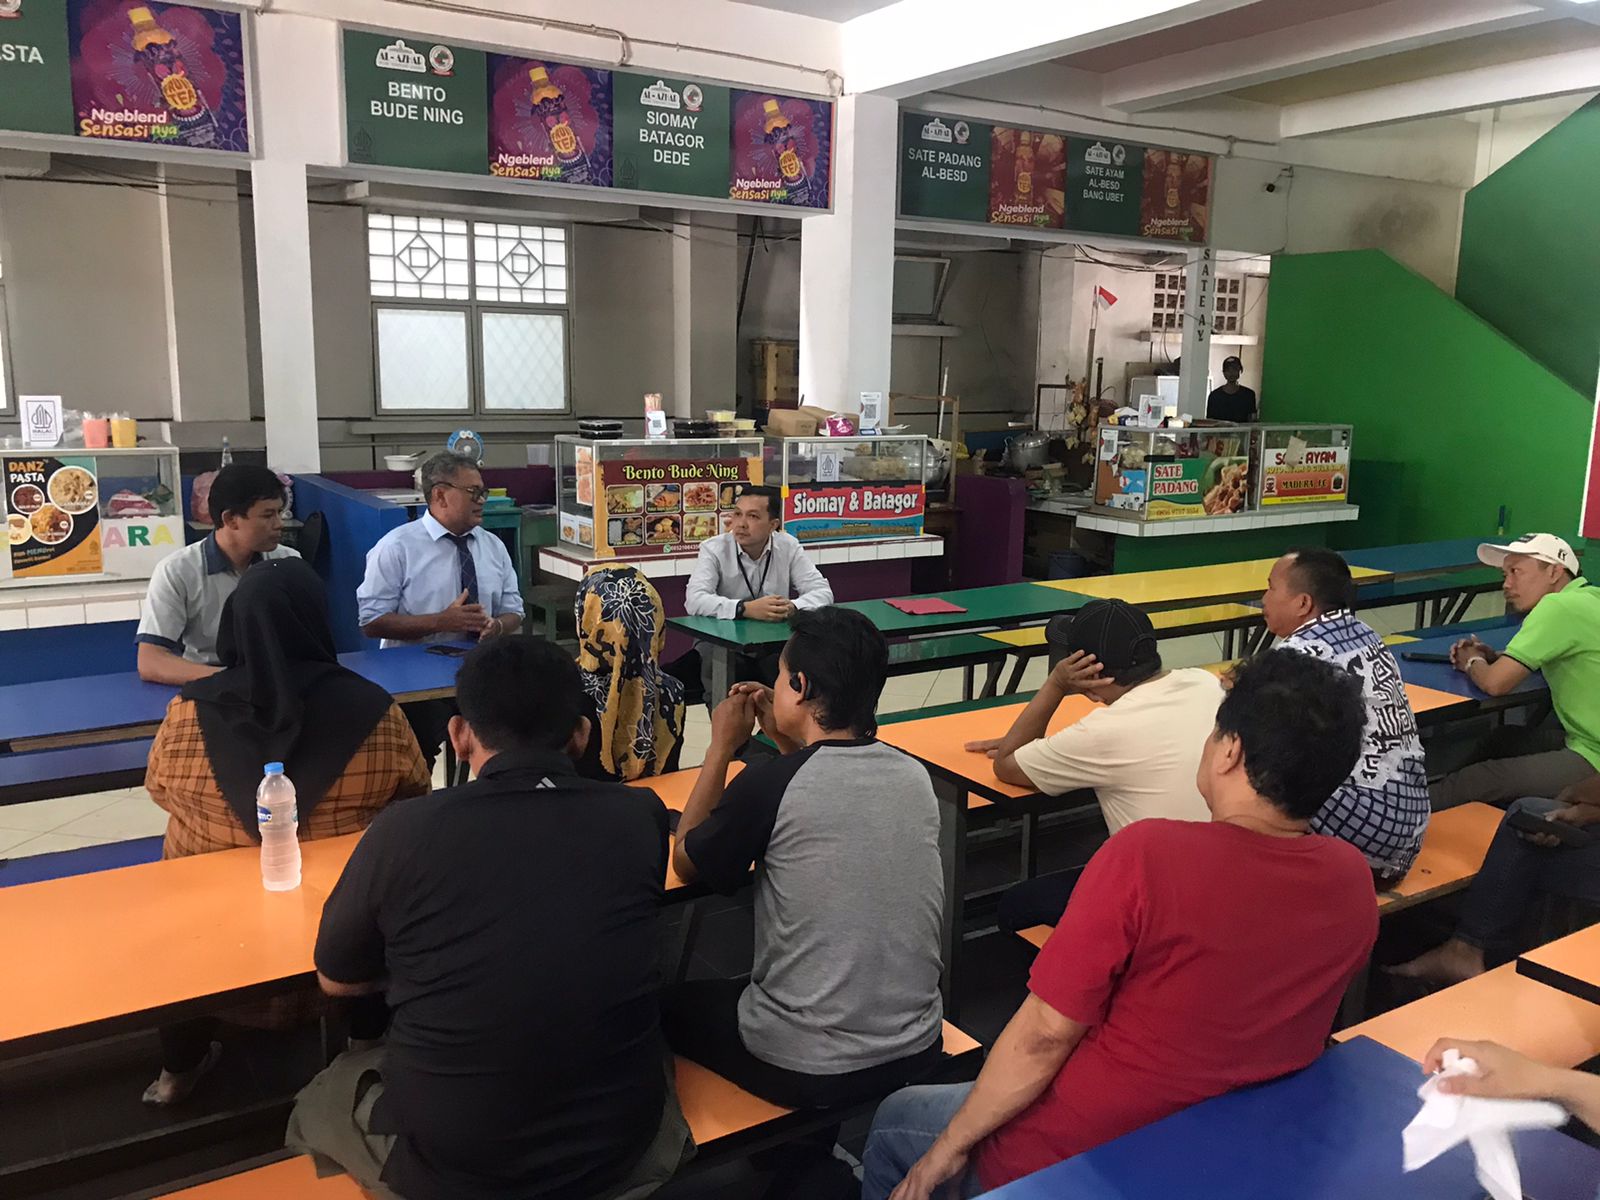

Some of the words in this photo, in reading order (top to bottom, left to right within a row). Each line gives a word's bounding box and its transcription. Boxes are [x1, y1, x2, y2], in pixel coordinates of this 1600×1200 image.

[0, 43, 44, 64] STA
[388, 81, 446, 103] BENTO
[91, 108, 167, 124] Ngeblend
[371, 100, 419, 120] BUDE
[423, 106, 464, 125] NING
[646, 111, 698, 130] SIOMAY
[80, 119, 147, 137] Sensasi
[151, 123, 179, 137] nya
[639, 129, 704, 149] BATAGOR
[498, 153, 554, 166] Ngeblend
[653, 149, 690, 166] DEDE
[908, 147, 936, 162] SATE
[938, 151, 982, 168] PADANG
[489, 162, 540, 177] Sensasi
[921, 166, 968, 182] AL-BESD
[1085, 165, 1104, 177] SATE
[1105, 168, 1124, 179] AYAM
[736, 178, 782, 190] Ngeblend
[1083, 189, 1104, 200] BANG
[998, 204, 1045, 214] Ngeblend
[1150, 217, 1190, 227] Ngeblend
[1305, 451, 1337, 464] AYAM
[8, 461, 45, 473] DANZ
[622, 464, 665, 480] Bento
[667, 463, 703, 480] Bude
[705, 464, 739, 480] Ning
[1154, 465, 1183, 479] SATE
[10, 472, 46, 483] PASTA
[1153, 479, 1198, 495] PADANG
[793, 491, 846, 516] Siomay
[849, 491, 859, 511] &
[863, 489, 918, 513] Batagor
